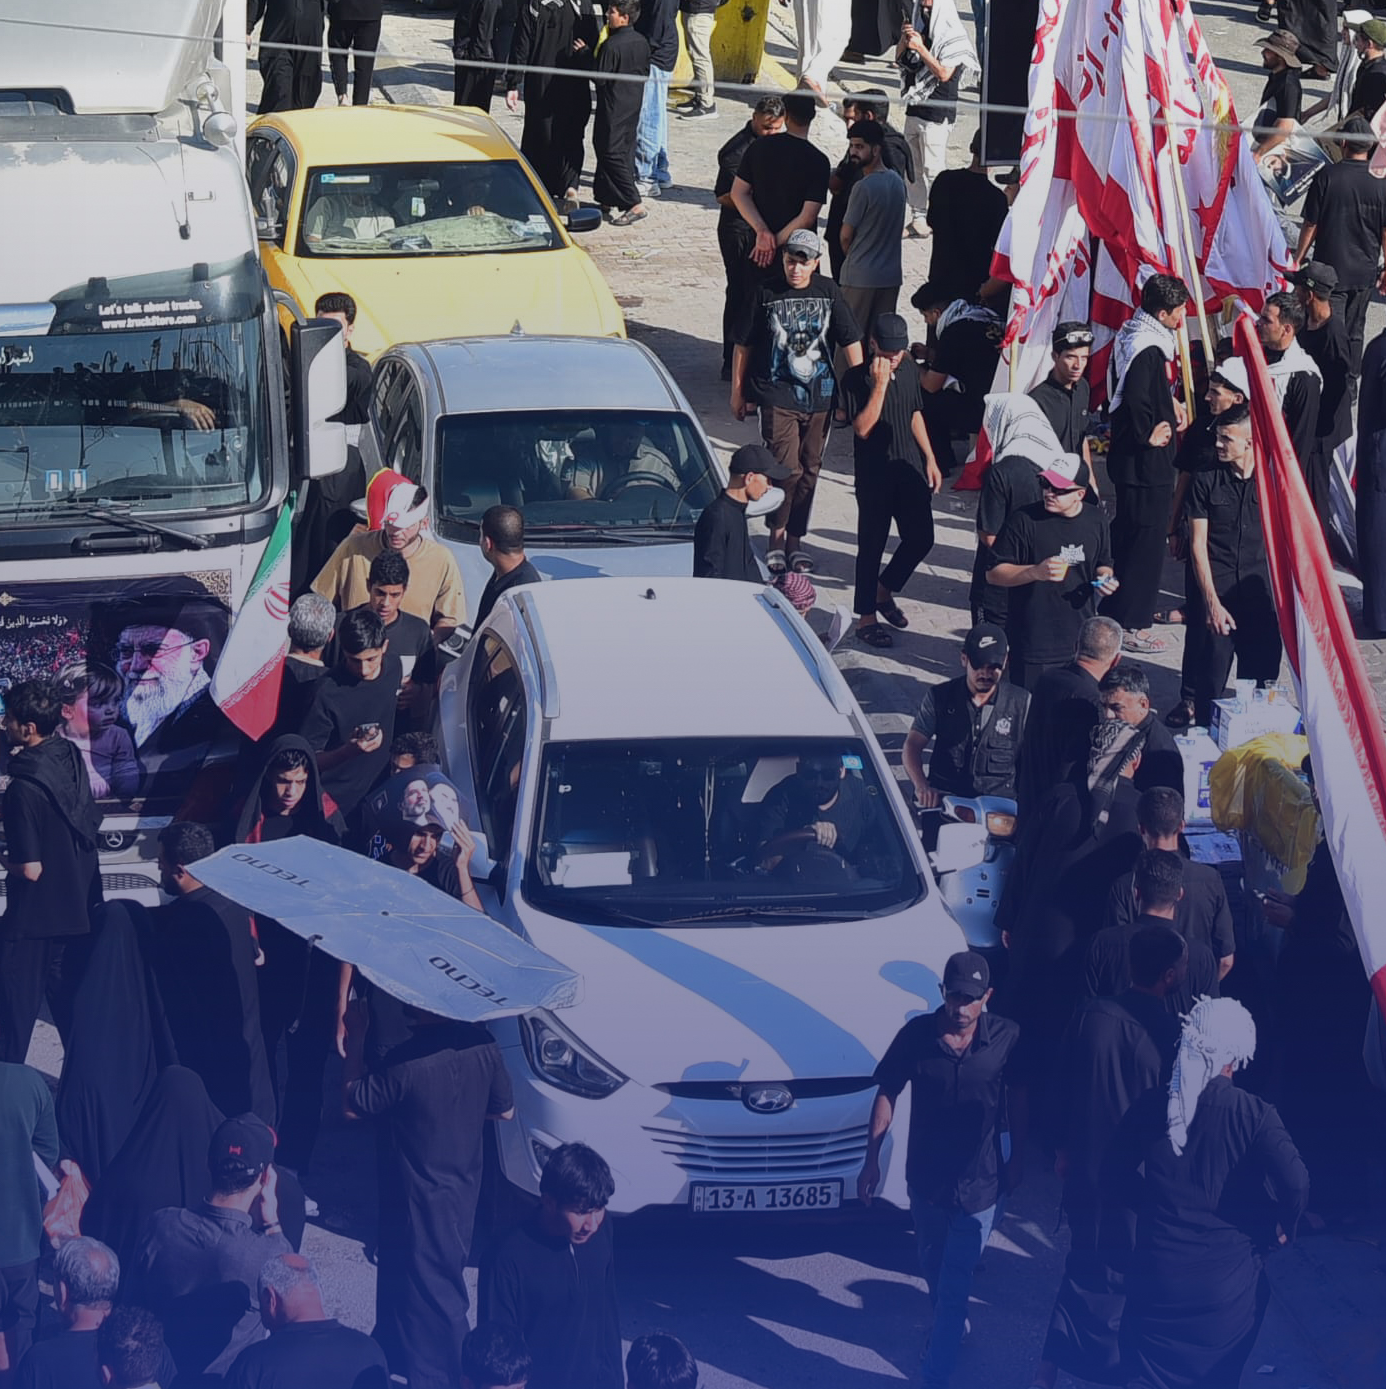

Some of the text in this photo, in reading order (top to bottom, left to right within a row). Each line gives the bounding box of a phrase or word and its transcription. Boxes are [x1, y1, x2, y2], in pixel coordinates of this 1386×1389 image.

[98, 303, 123, 316] Let's
[230, 852, 310, 889] TECNO
[428, 955, 510, 1008] TECNO
[765, 1185, 832, 1209] 13685
